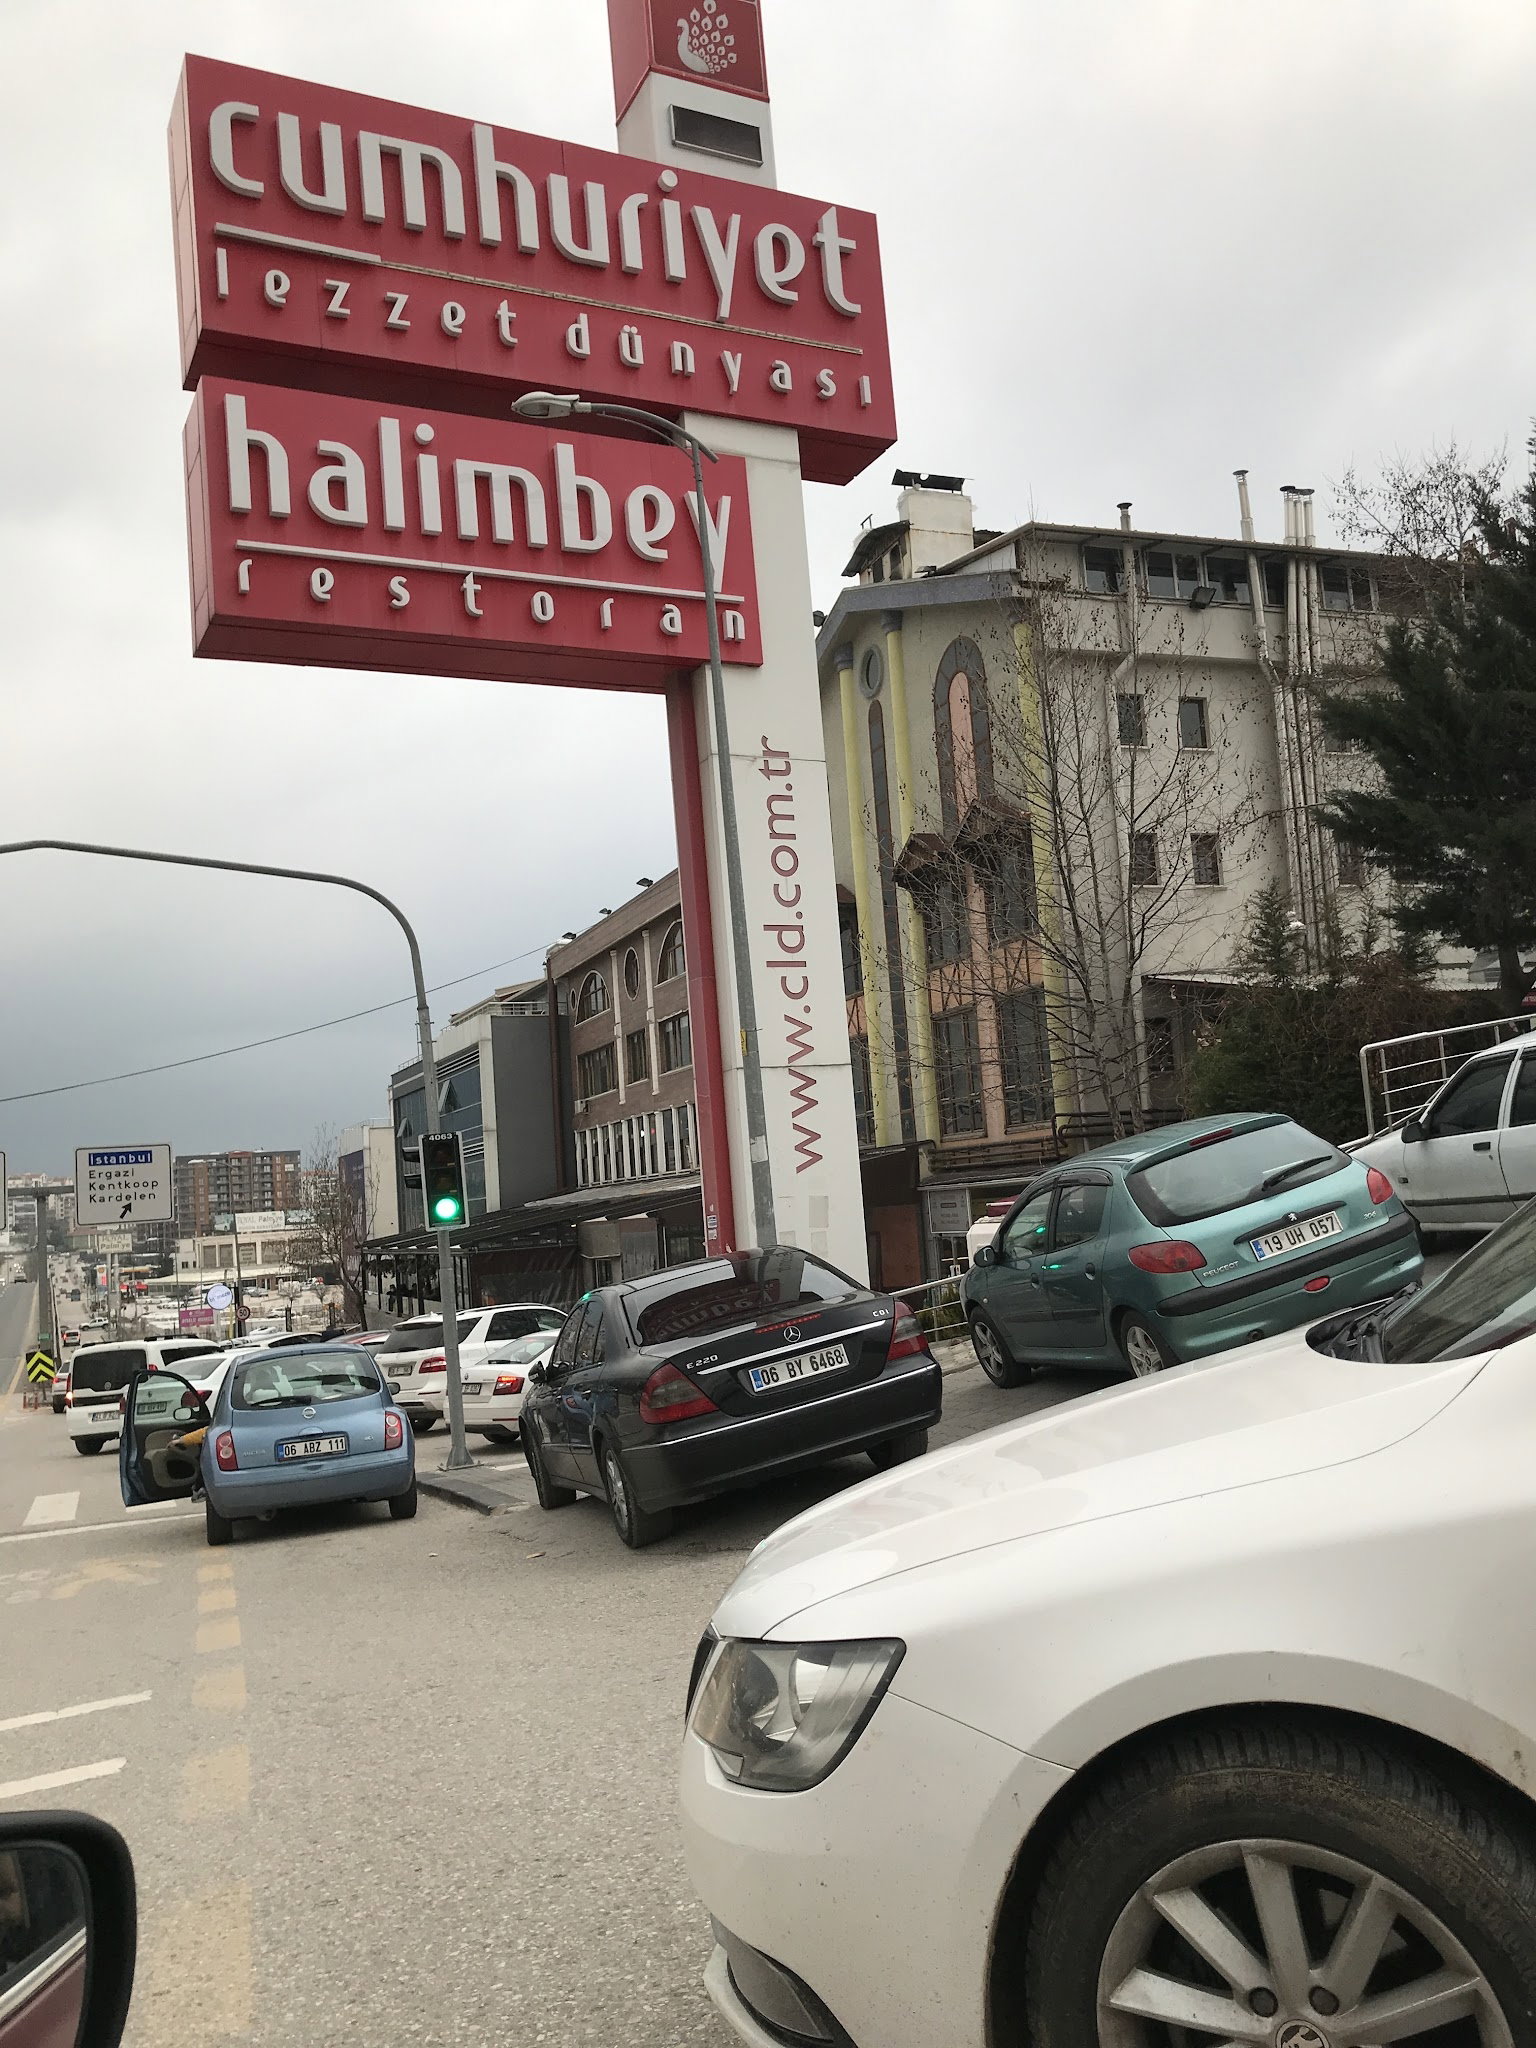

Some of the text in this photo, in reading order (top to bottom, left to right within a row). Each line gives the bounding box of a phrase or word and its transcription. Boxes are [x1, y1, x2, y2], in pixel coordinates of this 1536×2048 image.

[208, 101, 862, 322] cumhuriyet
[215, 247, 872, 407] lezzet dünyası
[222, 393, 732, 594] halimbey
[237, 558, 746, 642] restoran
[758, 735, 823, 1174] www.cld.com.tr
[428, 1133, 453, 1141] 4063
[88, 1168, 135, 1180] Ergazi
[88, 1179, 159, 1191] Kentkoop
[89, 1191, 156, 1203] Kardelen
[1264, 1235, 1284, 1253] 19
[1287, 1229, 1306, 1247] UH
[1309, 1216, 1336, 1238] 057
[1202, 1260, 1240, 1278] PEUGEOT
[239, 1308, 247, 1317] 50
[873, 1308, 890, 1317] CDI
[695, 1354, 719, 1367] 220
[760, 1366, 780, 1386] 06
[786, 1360, 804, 1379] BY
[811, 1349, 844, 1373] 6468
[284, 1445, 297, 1457] 06
[303, 1442, 322, 1454] ABZ
[328, 1438, 345, 1451] 111
